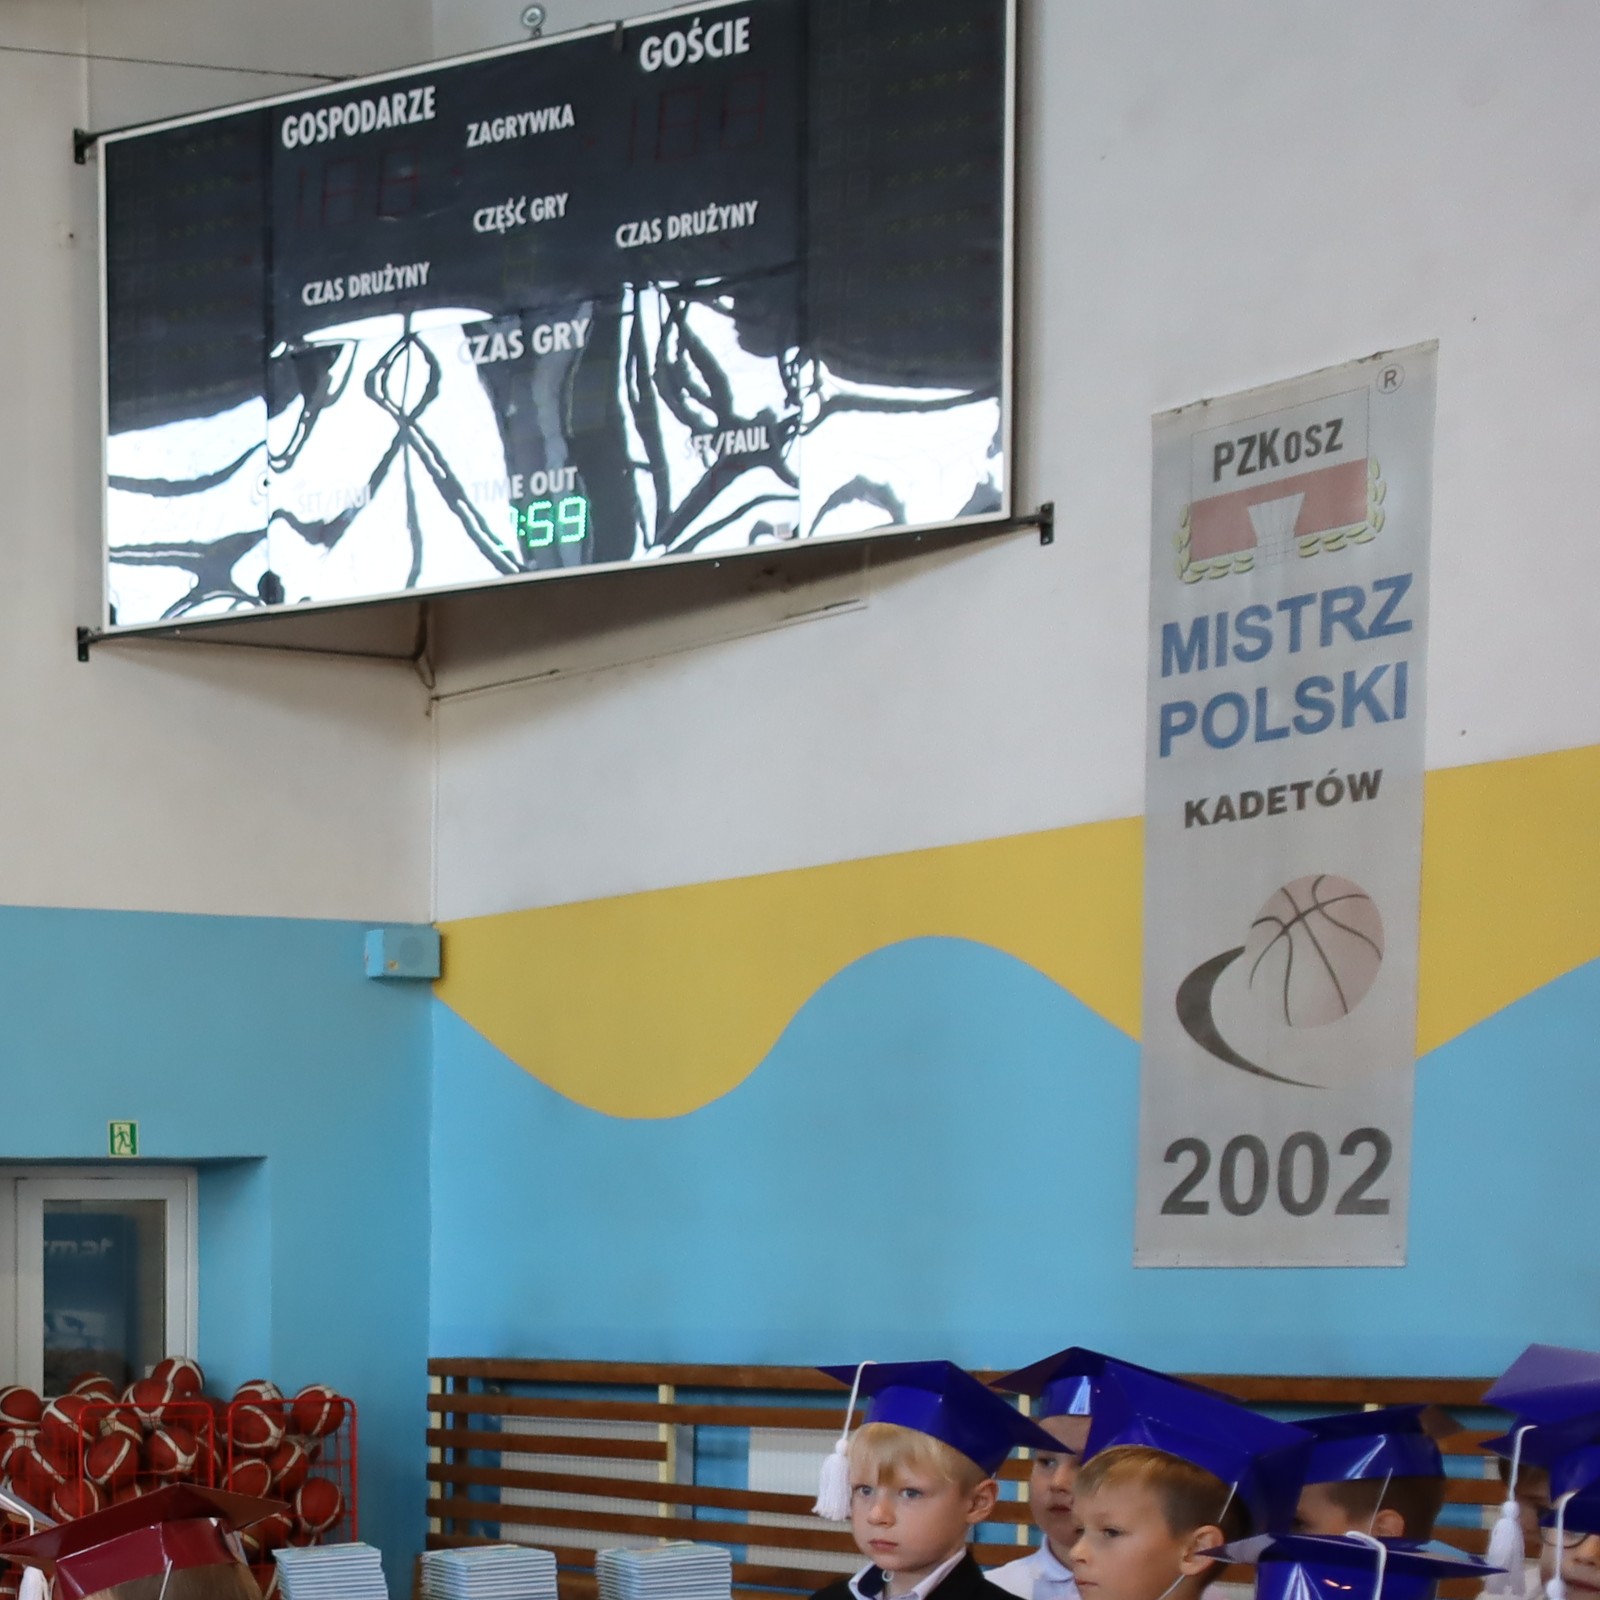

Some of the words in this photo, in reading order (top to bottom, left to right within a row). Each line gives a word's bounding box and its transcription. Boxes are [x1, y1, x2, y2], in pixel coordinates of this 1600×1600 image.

[640, 17, 751, 72] GOŚCIE
[282, 85, 436, 149] GOSPODARZE
[466, 104, 575, 148] ZAGRYWKA
[473, 196, 527, 233] CZĘŚĆ
[530, 193, 569, 223] GRY
[616, 218, 662, 248] CZAS
[667, 201, 758, 240] DRUŻYNY
[302, 278, 345, 306] CZAS
[349, 261, 431, 298] DRUŻYNY
[458, 329, 525, 365] CZAS
[532, 318, 591, 355] GRY
[685, 426, 770, 460] SET/FAUL
[530, 466, 579, 496] OUT
[1161, 572, 1413, 679] MISTRZ
[1159, 661, 1408, 759] POLSKI
[1184, 768, 1383, 829] KADETÓW
[1160, 1127, 1393, 1217] 2002
